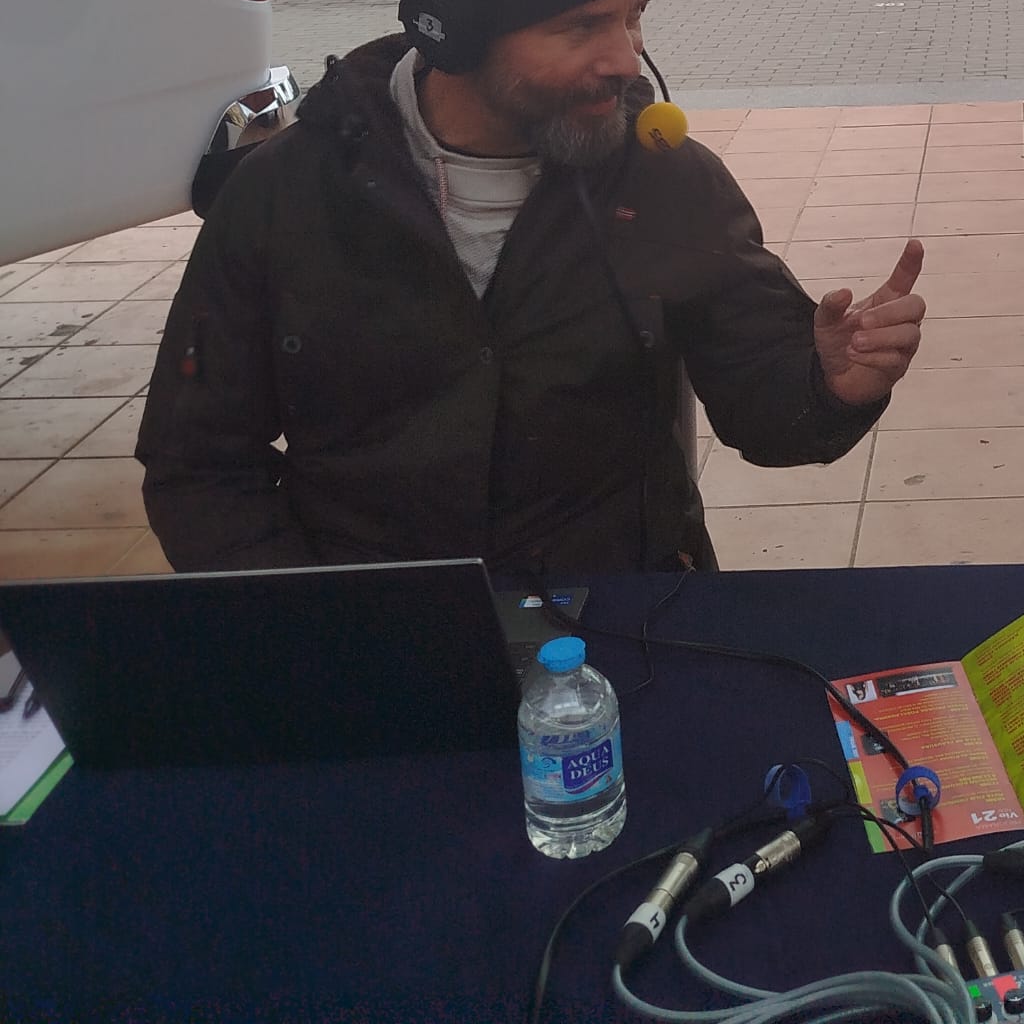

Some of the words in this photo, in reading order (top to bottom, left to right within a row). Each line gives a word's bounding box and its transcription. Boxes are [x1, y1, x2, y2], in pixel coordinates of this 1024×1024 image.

[568, 746, 609, 769] AQUA
[570, 759, 609, 780] DEUS
[970, 809, 998, 825] 21
[729, 873, 747, 891] 3
[649, 912, 661, 929] 4
